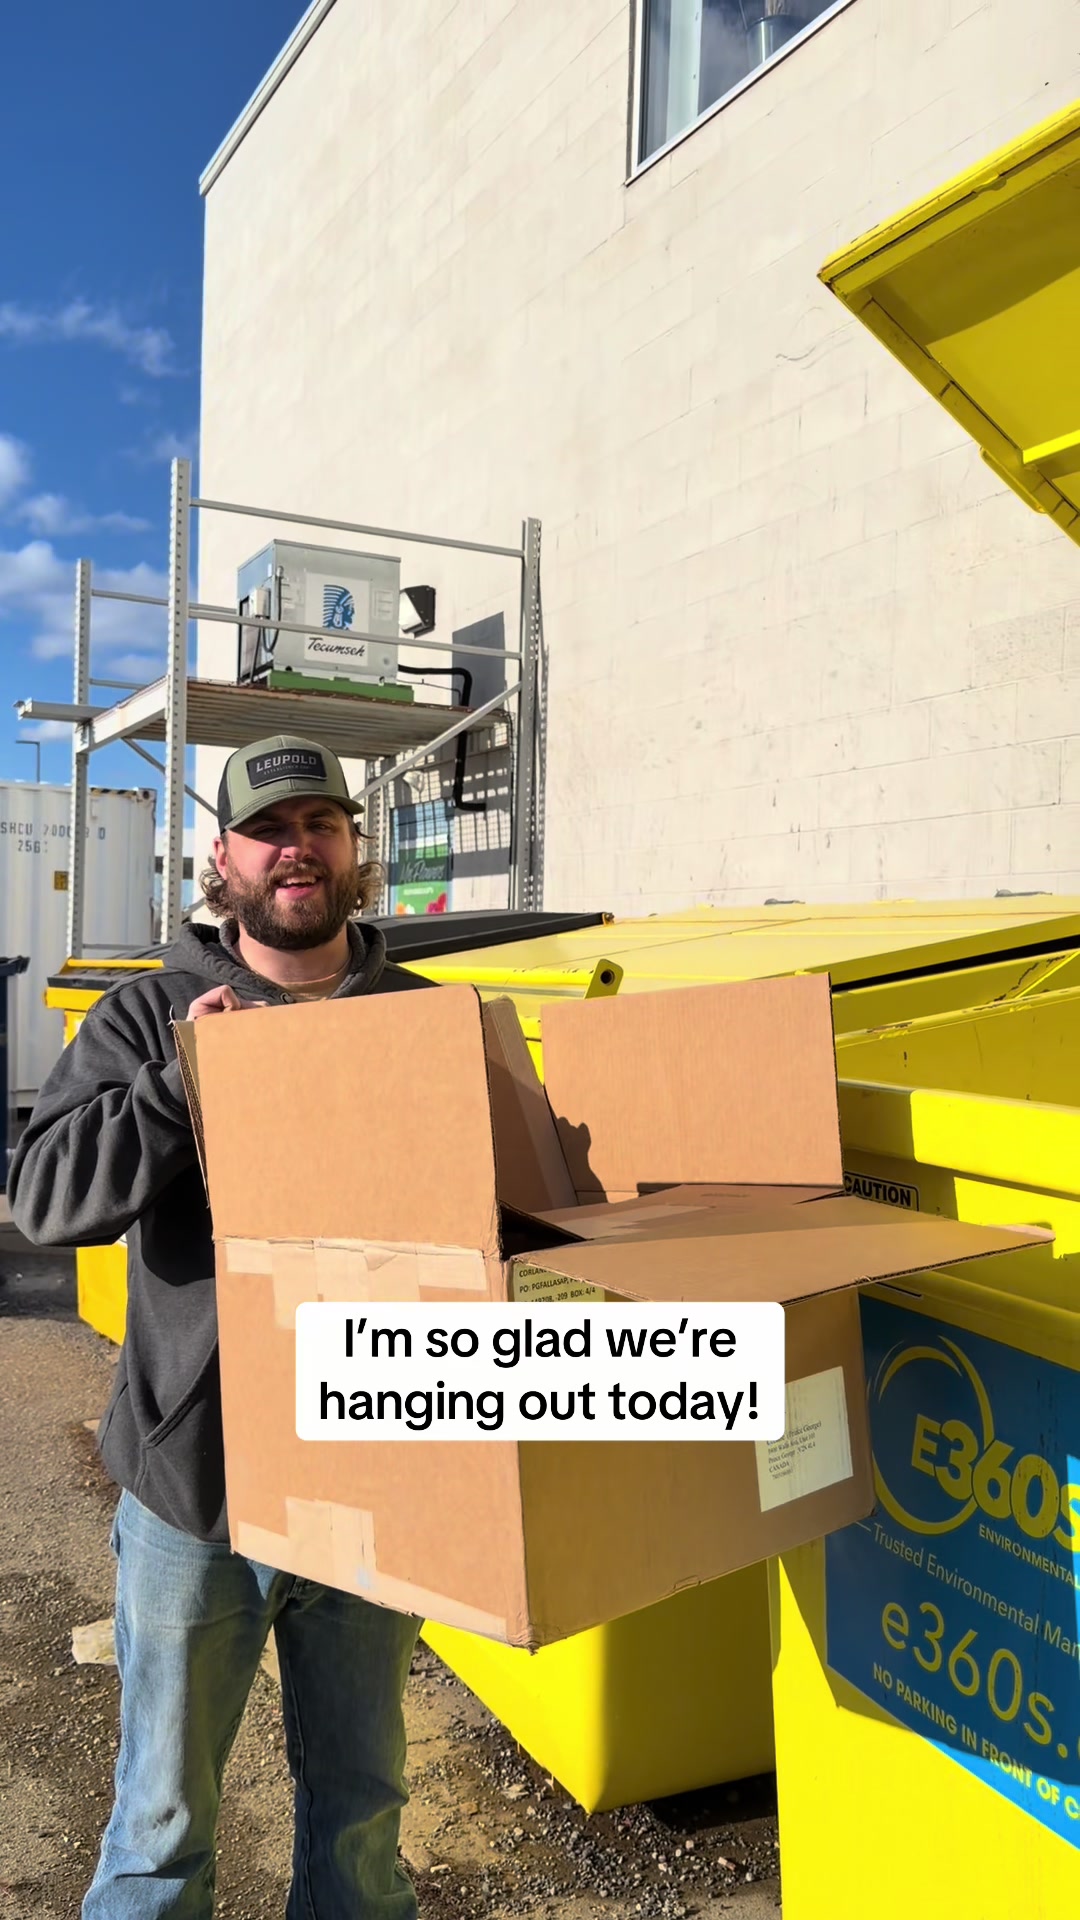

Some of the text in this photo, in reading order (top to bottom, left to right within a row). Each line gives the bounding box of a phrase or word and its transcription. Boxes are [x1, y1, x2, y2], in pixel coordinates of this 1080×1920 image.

[307, 636, 366, 657] Tecumseh
[256, 754, 317, 773] LEUPOLD
[844, 1175, 911, 1207] CAUTION
[873, 1522, 924, 1568] Trusted
[926, 1553, 1040, 1635] Environmental
[979, 1523, 1080, 1590] ENVIRONMENTAL
[881, 1602, 1080, 1758] e360s.
[873, 1662, 893, 1690] NO
[896, 1678, 958, 1735] PARKING
[961, 1723, 977, 1751] IN
[981, 1737, 1033, 1788] FRONT
[1036, 1777, 1060, 1806] OF
